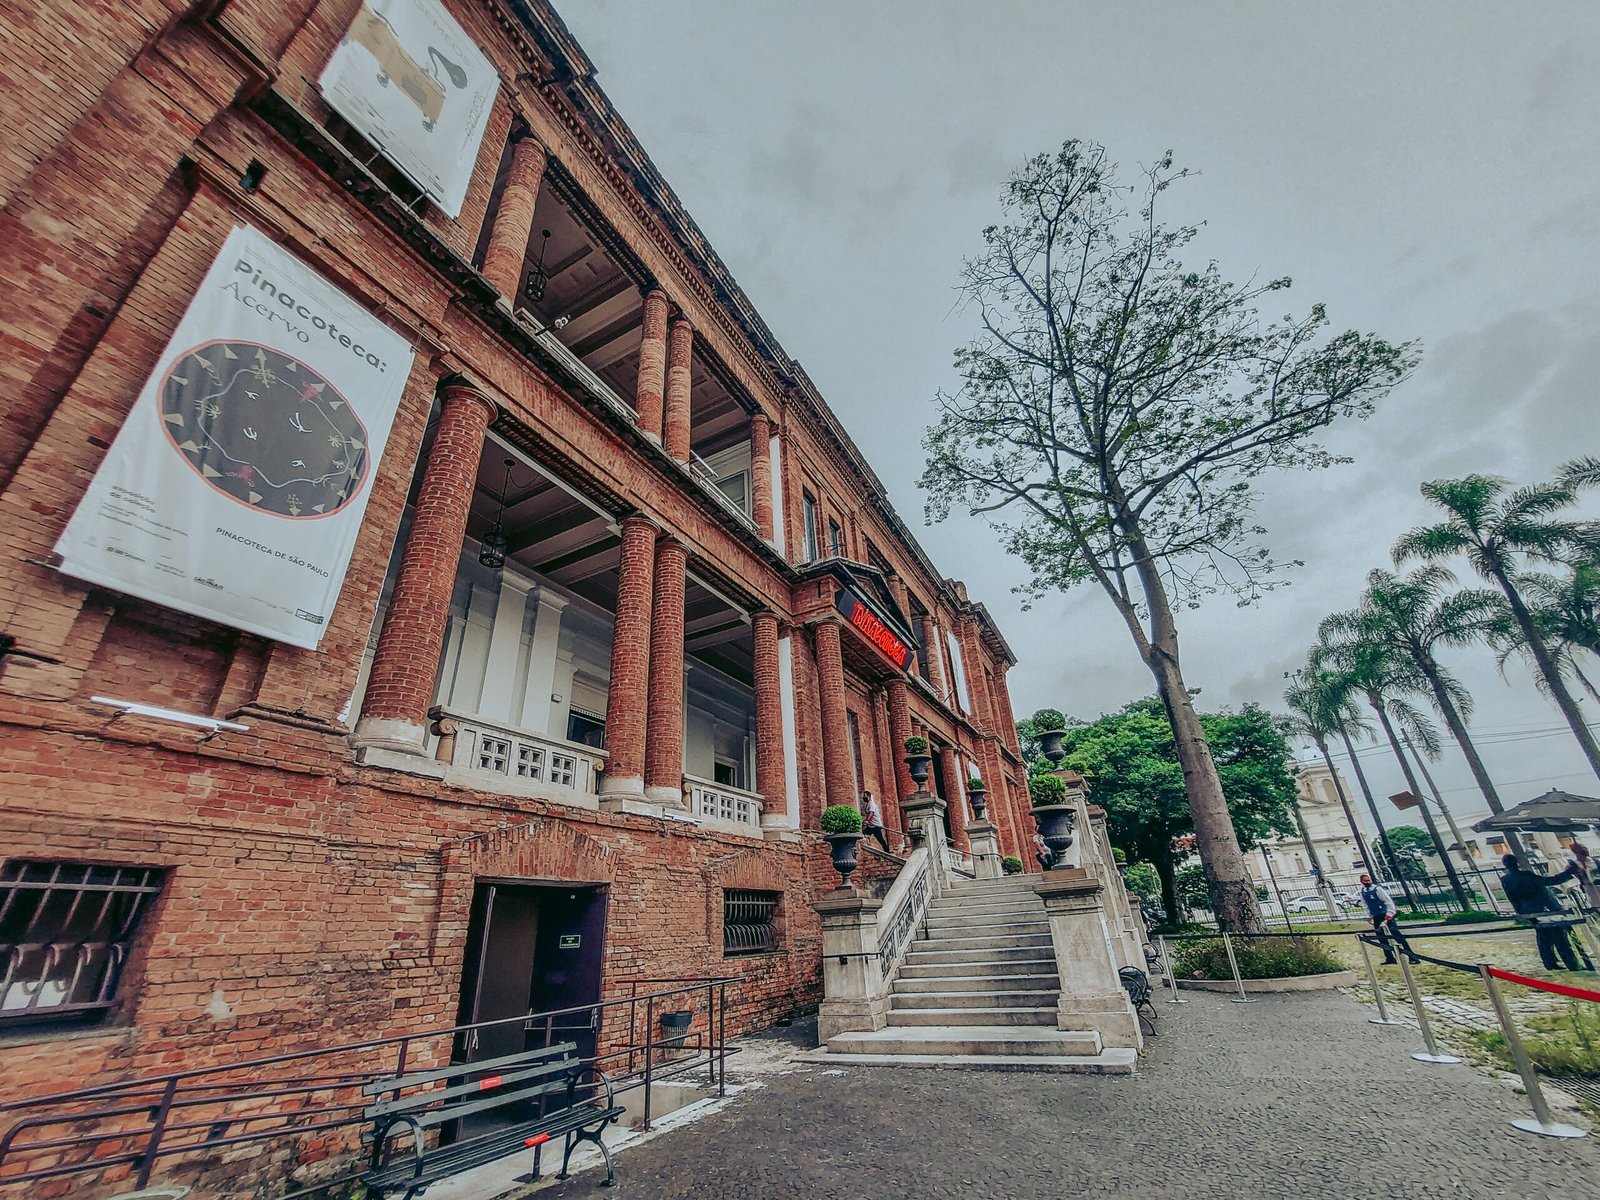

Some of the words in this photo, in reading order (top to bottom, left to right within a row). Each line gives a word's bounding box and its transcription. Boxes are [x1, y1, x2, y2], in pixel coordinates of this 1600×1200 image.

[220, 281, 310, 343] Acervo
[233, 258, 388, 373] Pinacoteca:
[215, 527, 273, 555] PINACOTECA
[274, 550, 286, 560] DE
[287, 555, 306, 567] SÃO
[306, 562, 329, 578] PAULO
